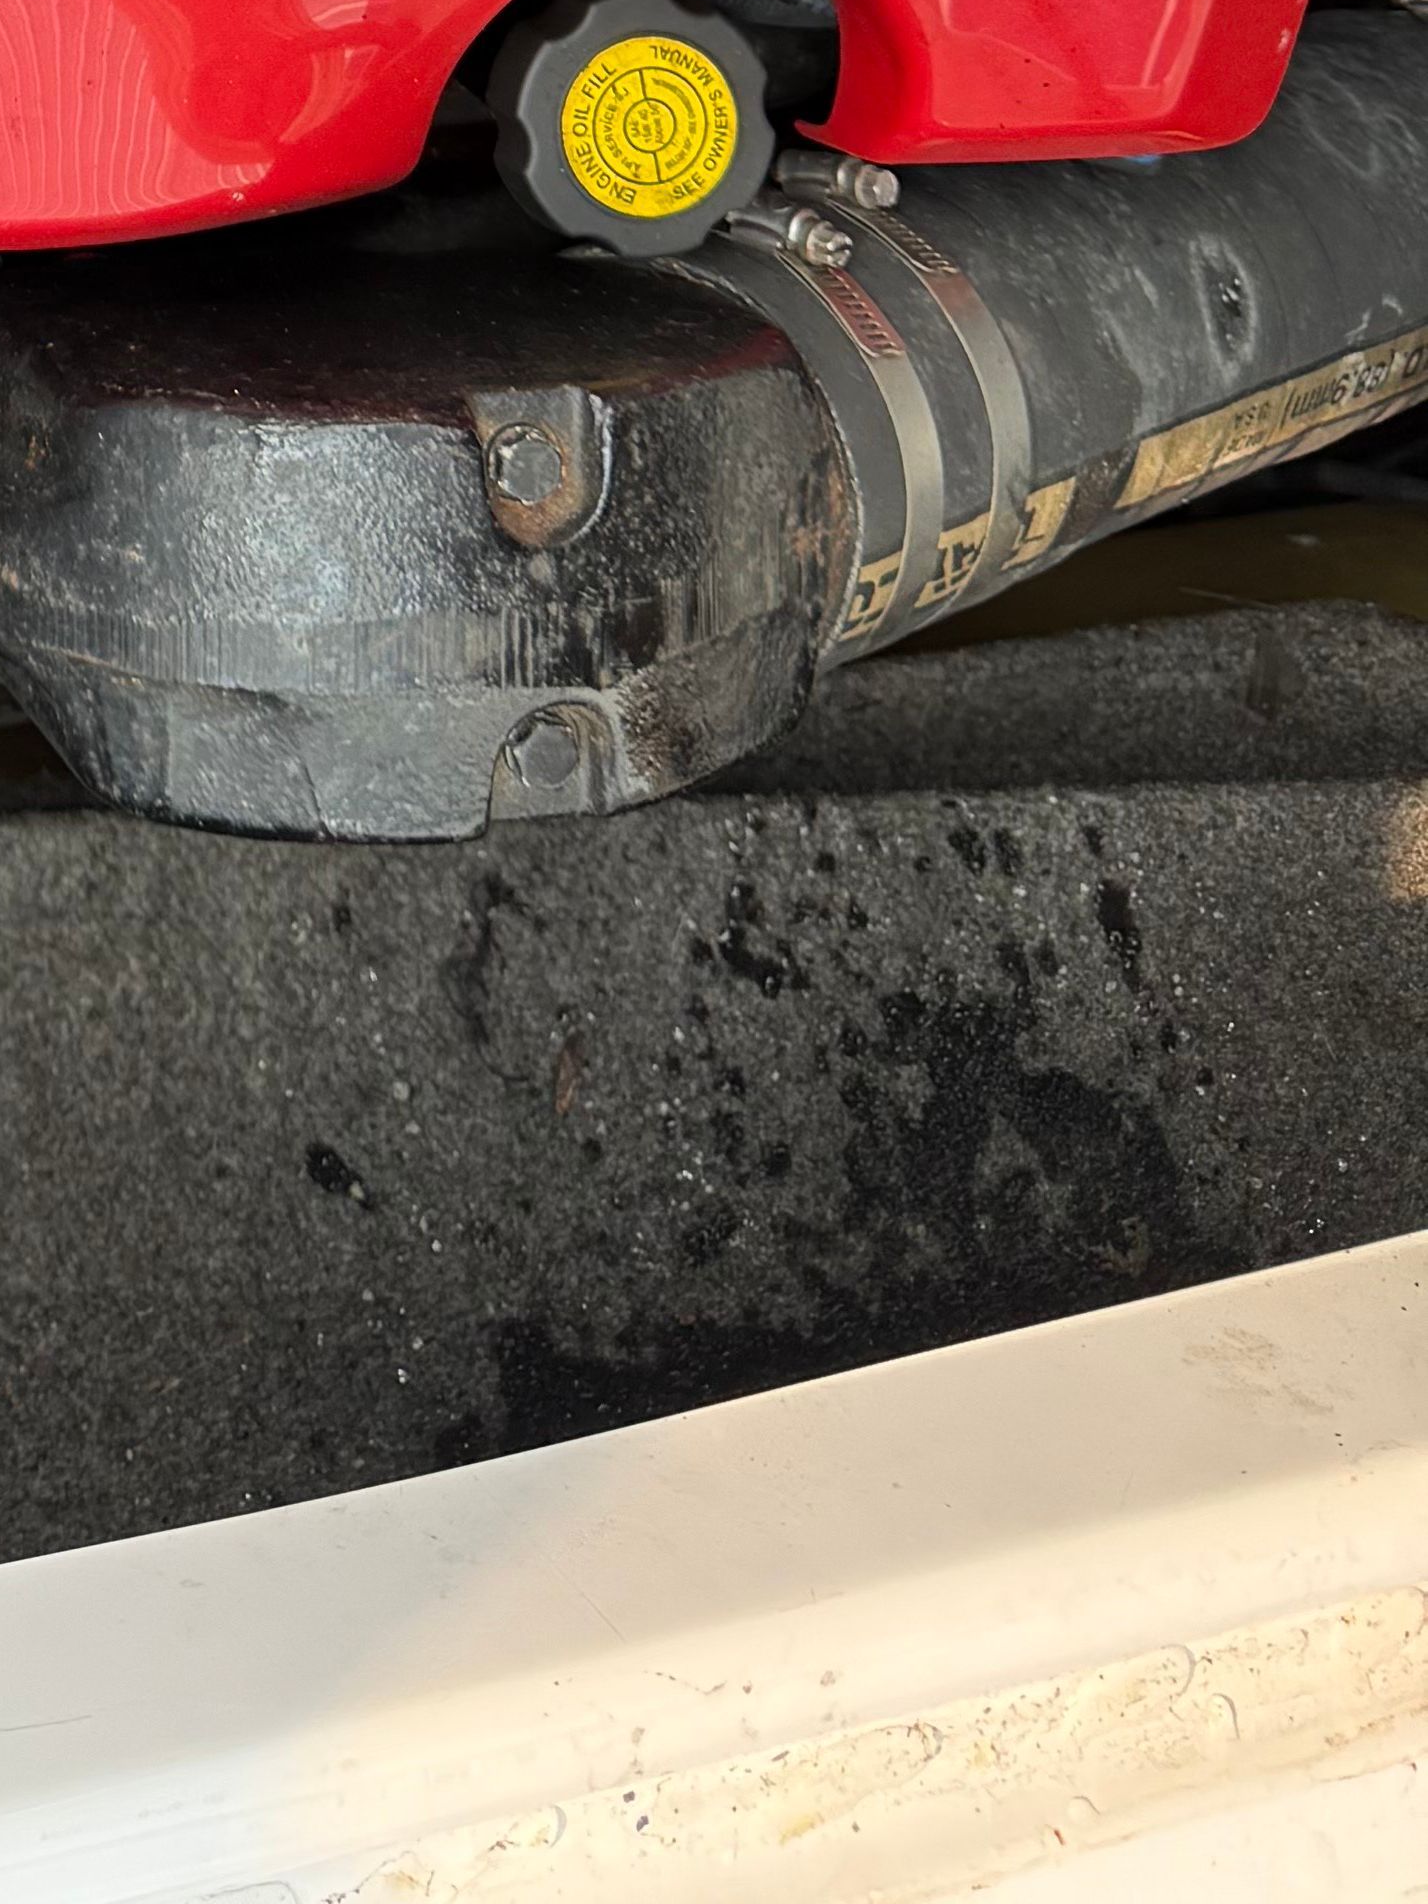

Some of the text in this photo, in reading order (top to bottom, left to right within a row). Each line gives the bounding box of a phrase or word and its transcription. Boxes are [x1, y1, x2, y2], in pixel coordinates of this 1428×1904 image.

[583, 62, 618, 101] FILL
[649, 43, 715, 88] MANUAL
[572, 104, 592, 138] OIL
[600, 101, 624, 160] SERVICE
[574, 142, 638, 206] ENGINE
[671, 171, 706, 201] SEE
